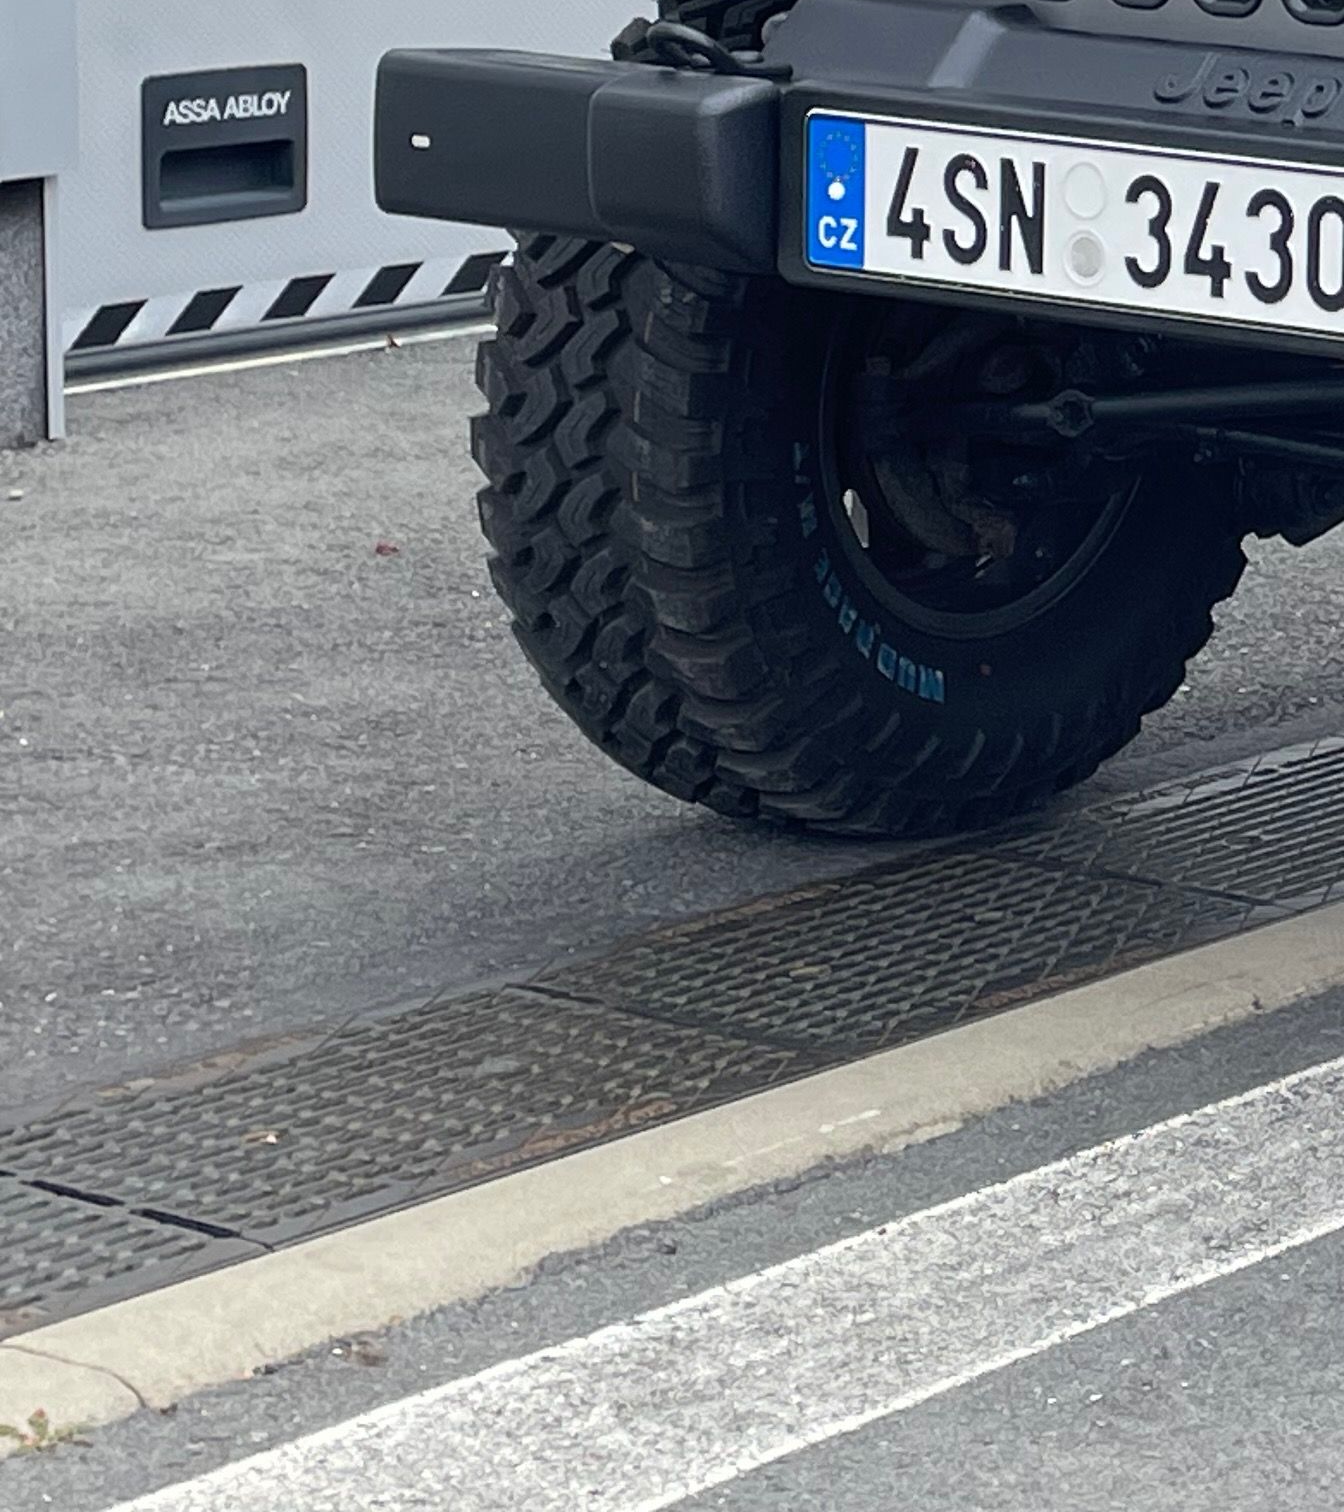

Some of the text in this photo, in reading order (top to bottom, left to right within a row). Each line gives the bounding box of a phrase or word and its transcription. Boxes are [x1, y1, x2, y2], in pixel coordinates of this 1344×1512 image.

[162, 90, 292, 127] ASSA ABLOY
[1152, 52, 1344, 128] Jeep
[817, 215, 858, 252] CZ
[886, 146, 1047, 275] 4SN
